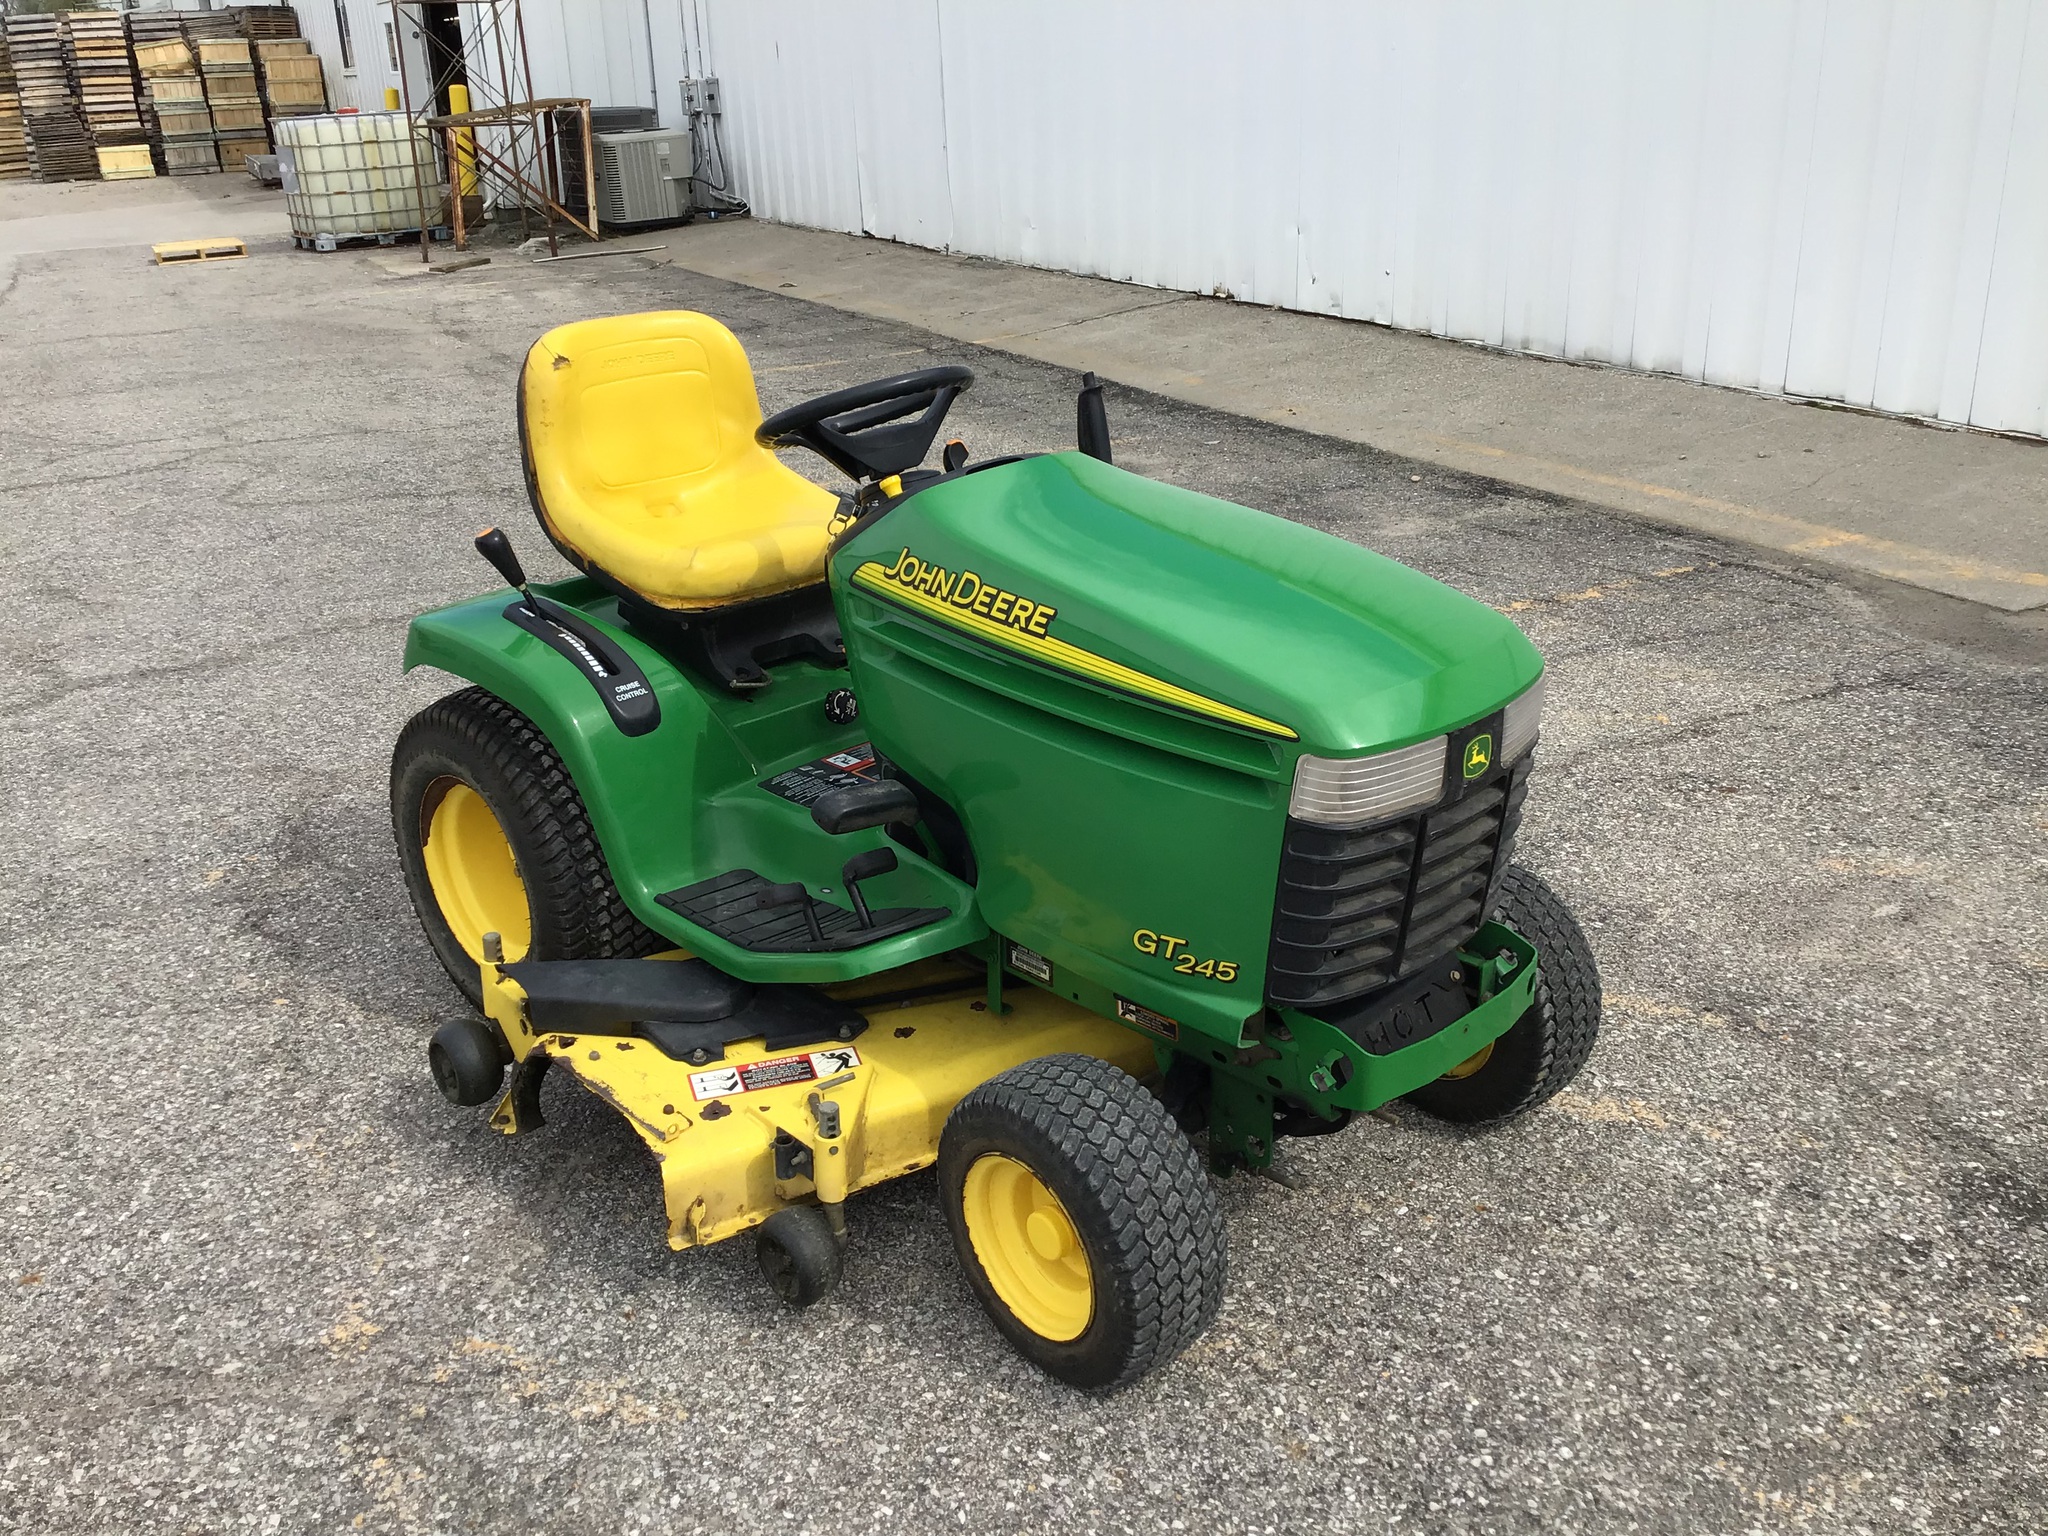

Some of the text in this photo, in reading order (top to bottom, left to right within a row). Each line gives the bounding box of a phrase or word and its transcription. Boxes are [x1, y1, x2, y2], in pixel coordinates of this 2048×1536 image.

[884, 547, 1058, 641] JOHN DEERE
[615, 680, 641, 693] CRUISE
[615, 689, 649, 702] CONTROL
[757, 1056, 800, 1068] DANGER
